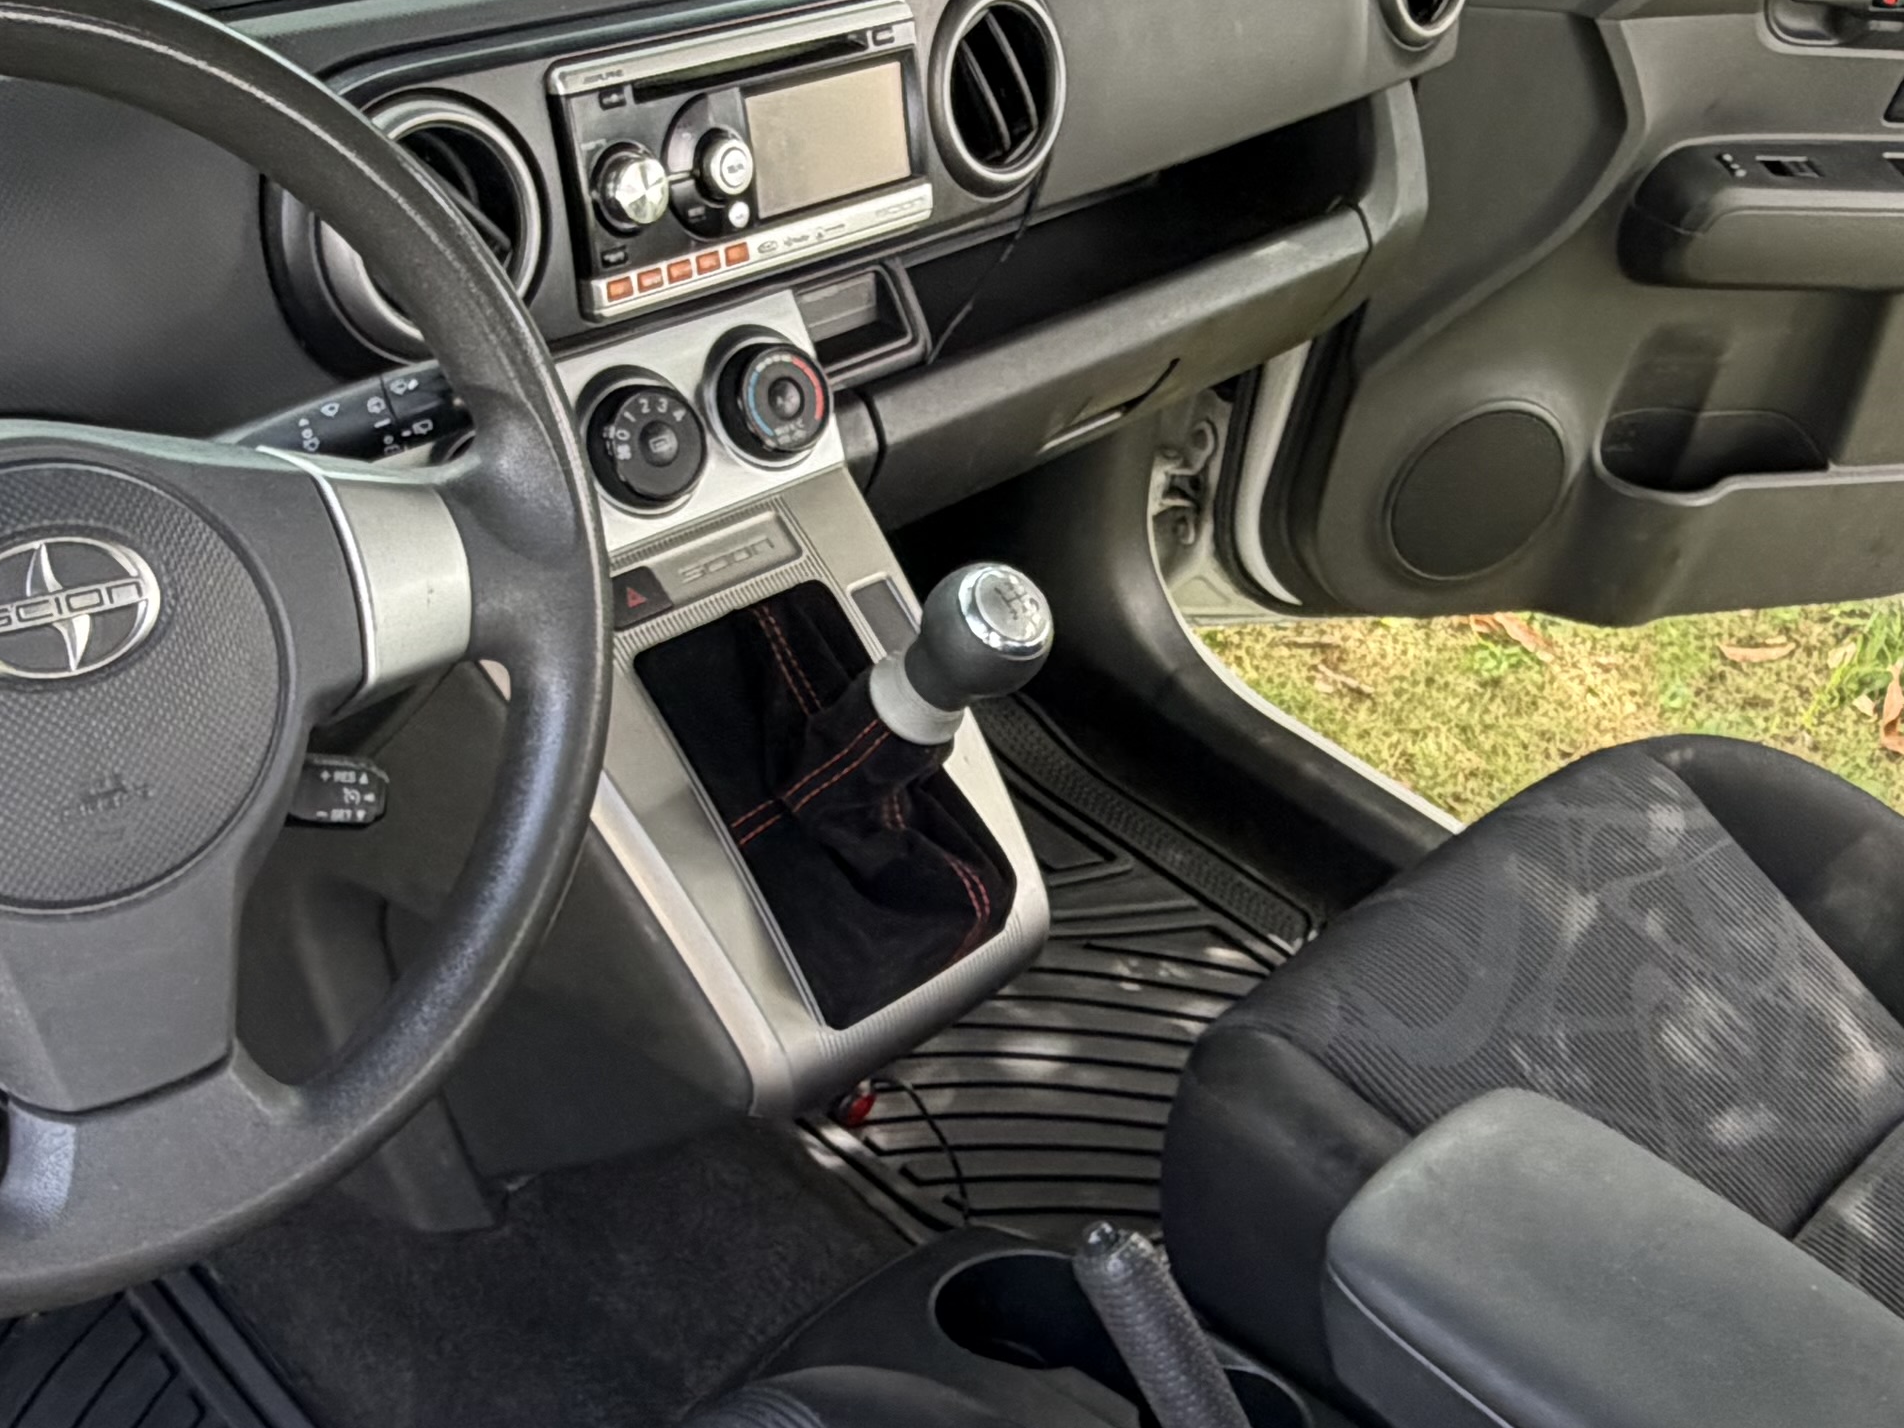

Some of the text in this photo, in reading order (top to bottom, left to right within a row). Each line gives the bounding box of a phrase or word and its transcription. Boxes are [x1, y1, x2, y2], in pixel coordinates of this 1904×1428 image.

[639, 398, 650, 413] 2
[657, 398, 668, 413] 3
[624, 411, 636, 422] 1
[673, 409, 686, 421] 4
